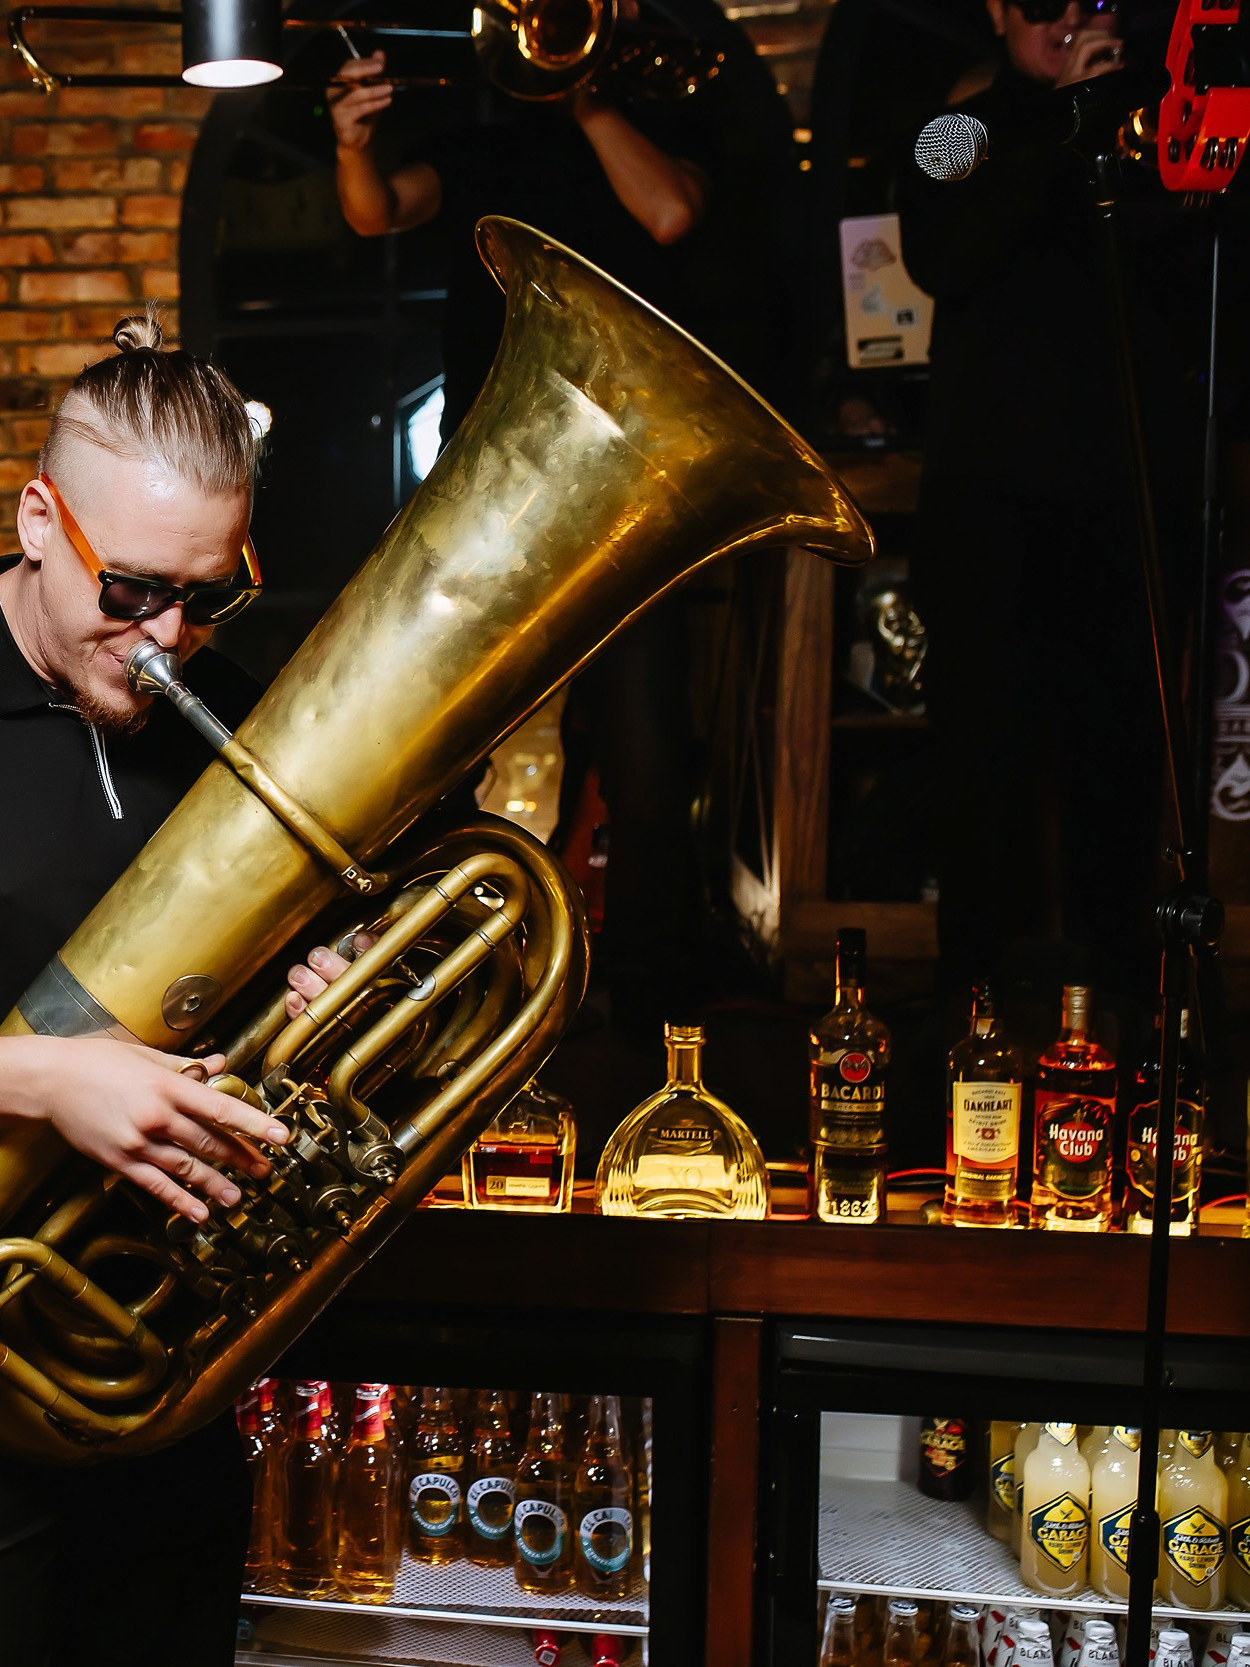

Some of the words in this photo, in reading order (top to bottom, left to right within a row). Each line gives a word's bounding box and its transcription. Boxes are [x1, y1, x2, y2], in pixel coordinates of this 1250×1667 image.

[963, 1099, 1013, 1112] OAKHEART
[660, 1129, 711, 1140] MARTELL
[1049, 1123, 1104, 1142] Havana
[1142, 1127, 1199, 1146] Haana
[1059, 1141, 1093, 1156] Club
[489, 1180, 504, 1190] 20
[669, 1167, 703, 1189] XO
[418, 1476, 459, 1498] CAPULCO
[1168, 1539, 1224, 1555] GARAGE
